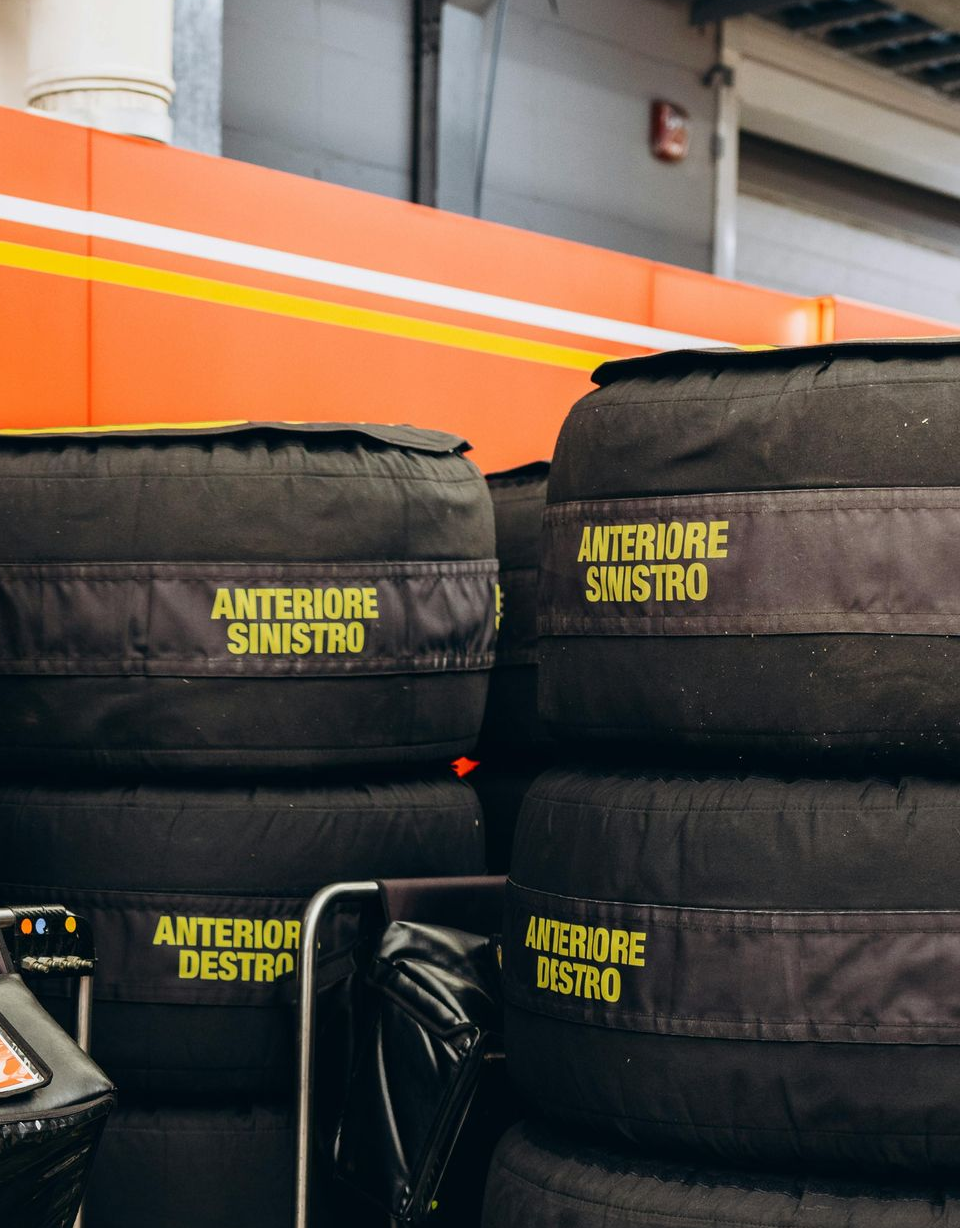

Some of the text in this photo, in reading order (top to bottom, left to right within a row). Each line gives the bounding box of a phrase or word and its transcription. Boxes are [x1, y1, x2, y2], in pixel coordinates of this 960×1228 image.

[577, 521, 729, 562] ANTERIORE
[585, 562, 708, 602] SINISTRO
[210, 587, 379, 620] ANTERIORE
[227, 622, 365, 654] SINISTRO
[153, 916, 320, 949] ANTERIOR
[525, 915, 647, 967] ANTERIORE
[179, 949, 293, 982] DESTRO
[536, 955, 621, 1004] DESTRO
